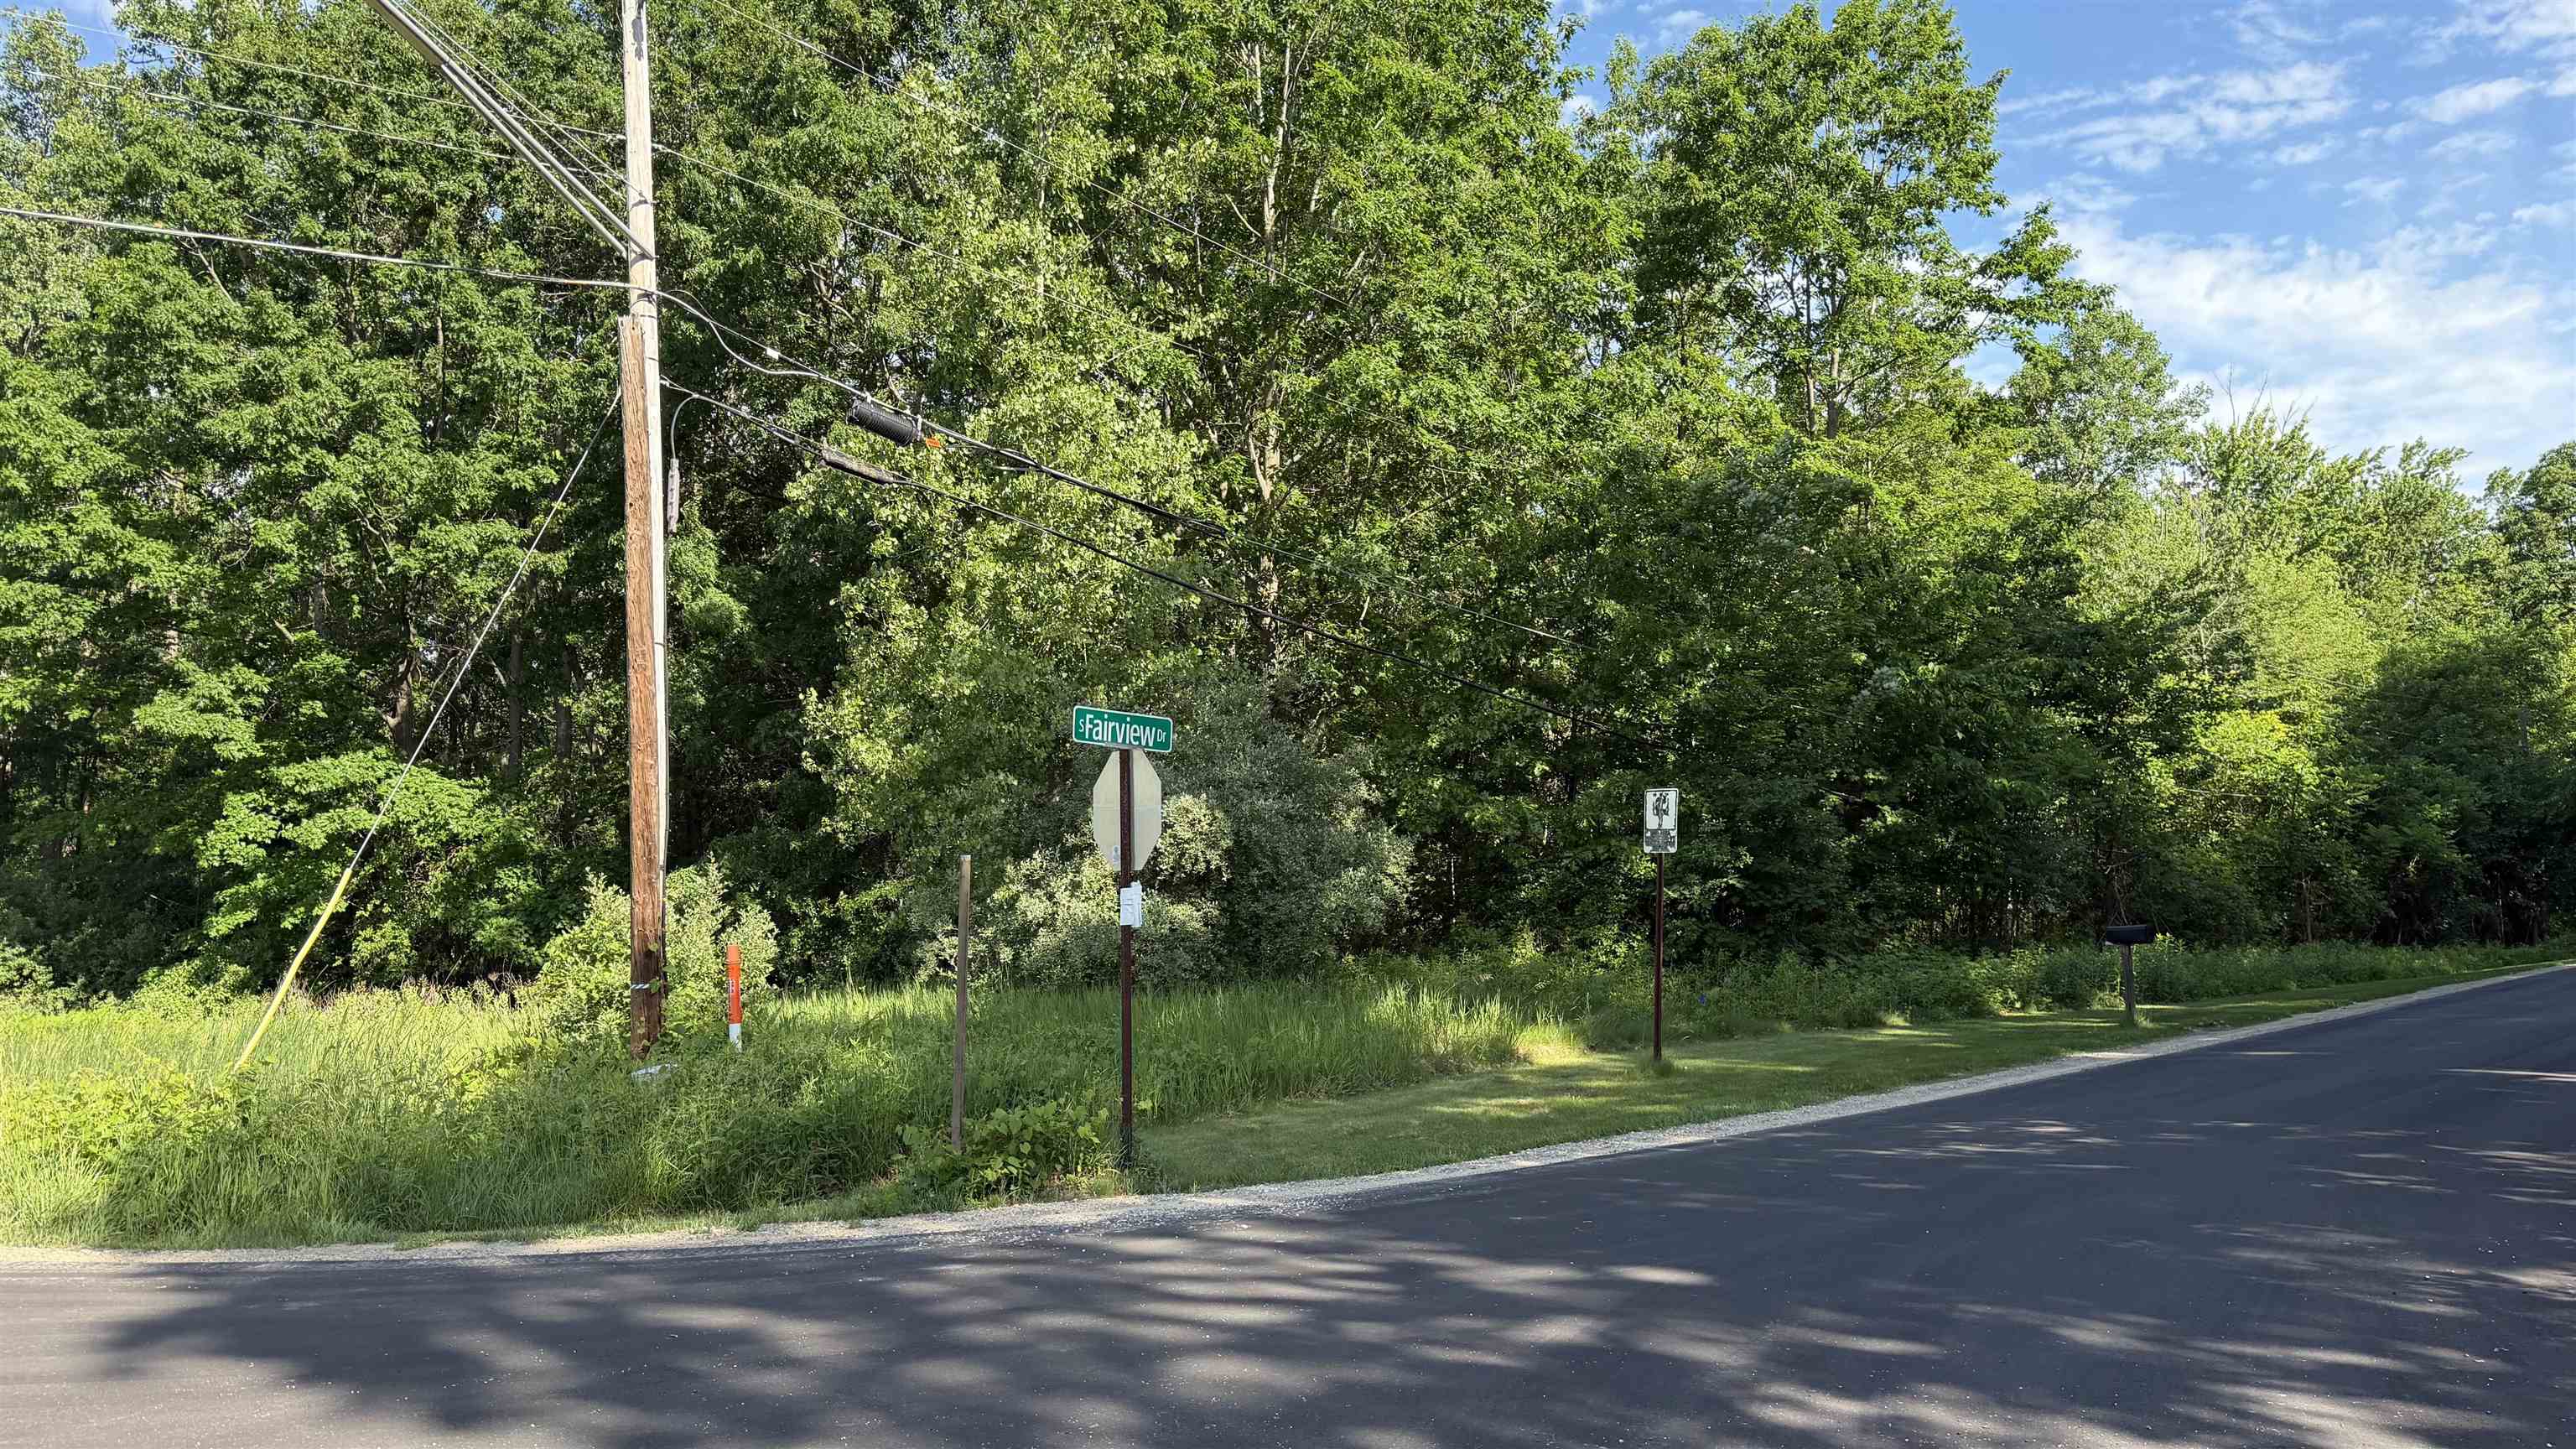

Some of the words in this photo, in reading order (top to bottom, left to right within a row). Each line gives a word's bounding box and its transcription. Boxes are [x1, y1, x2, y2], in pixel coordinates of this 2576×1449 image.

[1078, 719, 1084, 732] S
[1085, 714, 1156, 746] Fairview
[1156, 729, 1166, 743] Dr
